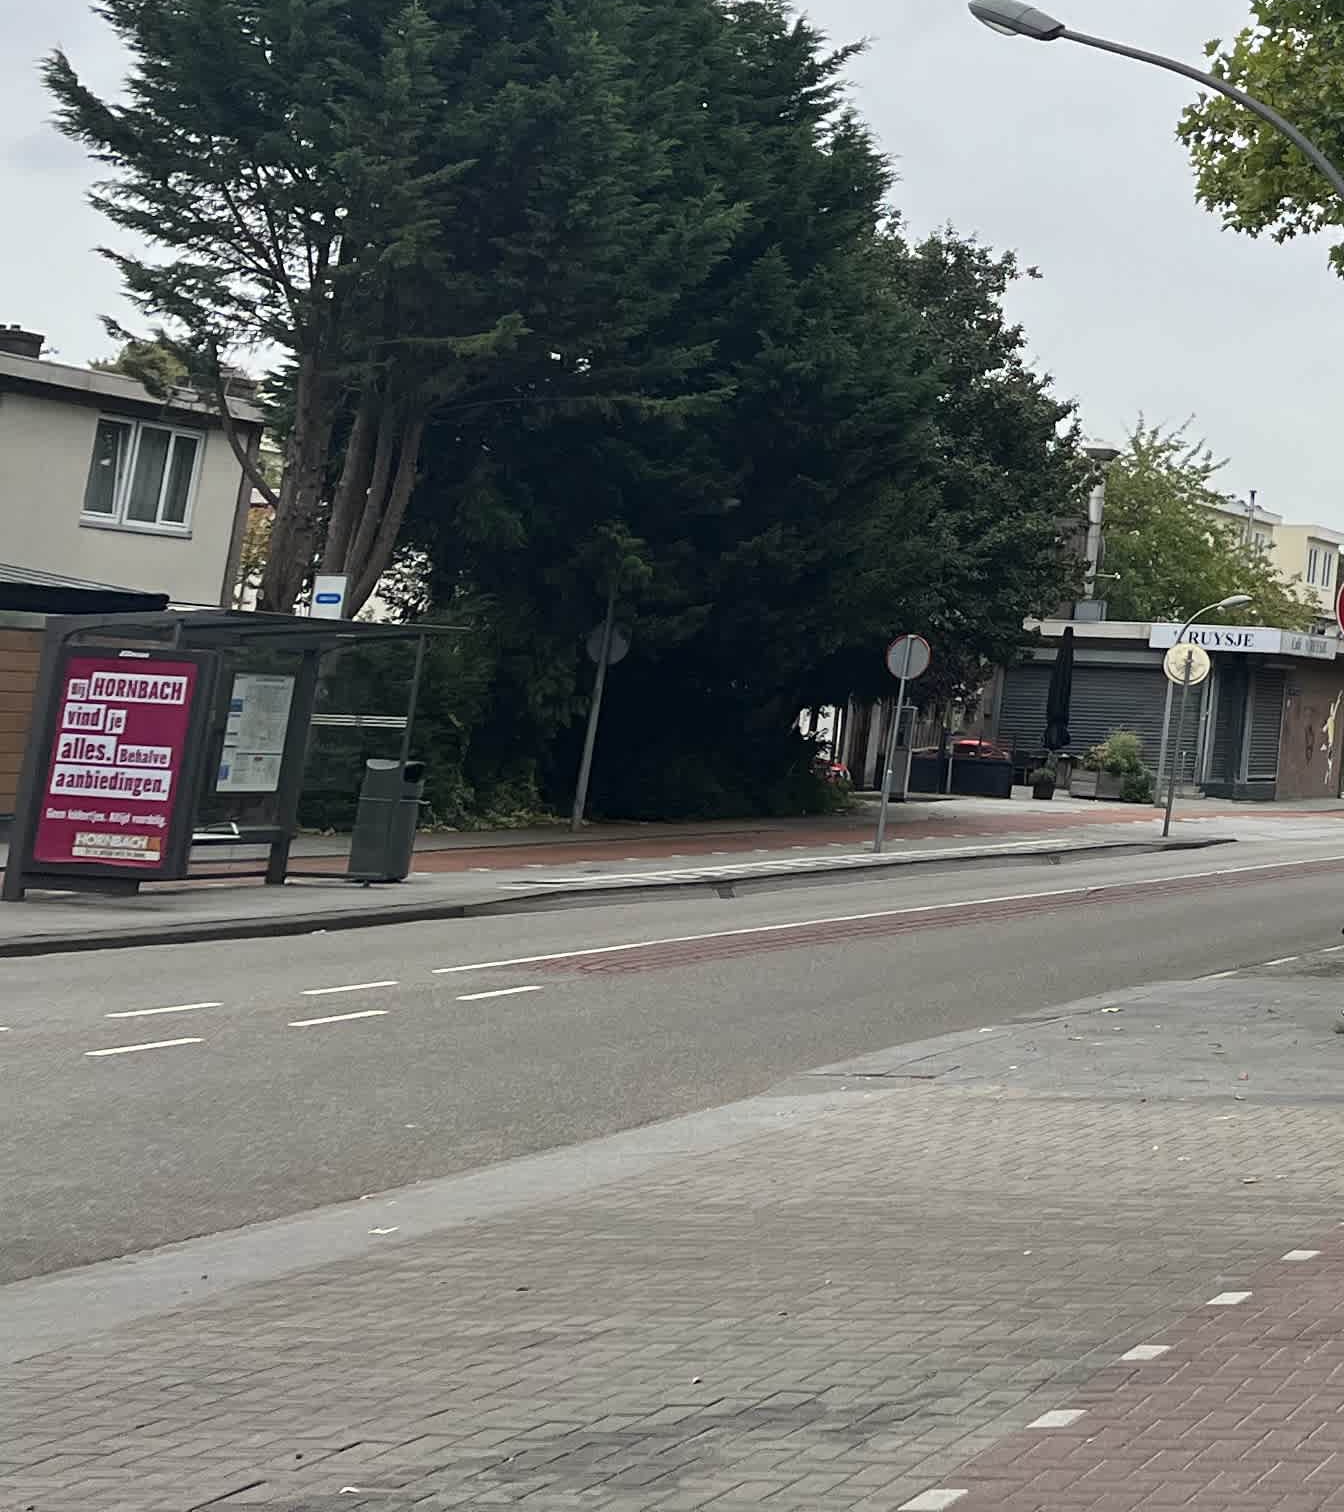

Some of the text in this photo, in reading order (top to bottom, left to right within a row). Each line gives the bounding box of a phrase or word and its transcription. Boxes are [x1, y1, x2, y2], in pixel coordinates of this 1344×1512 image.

[1188, 631, 1255, 648] RUYSJE
[92, 677, 184, 701] HORNBACH
[68, 706, 122, 731] vind je
[60, 737, 168, 765] alles. Behalve
[55, 770, 168, 797] aanbiedingen.
